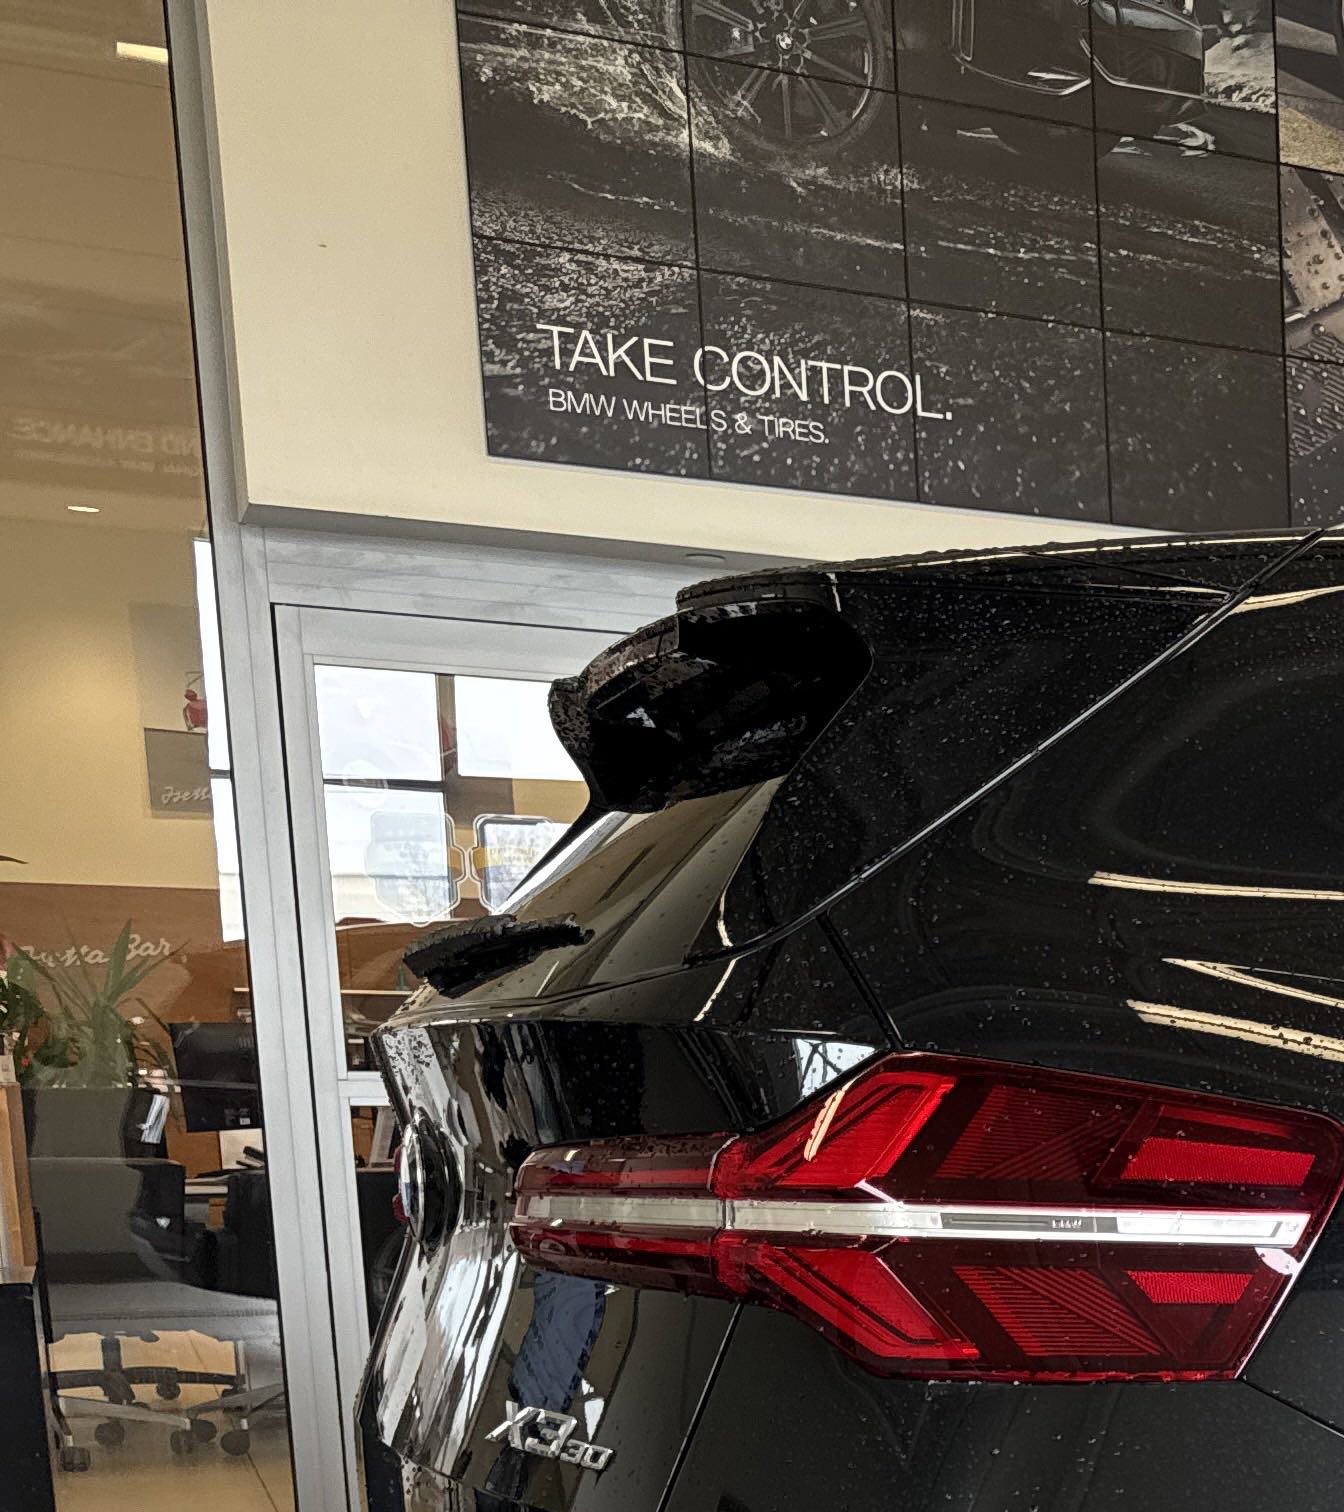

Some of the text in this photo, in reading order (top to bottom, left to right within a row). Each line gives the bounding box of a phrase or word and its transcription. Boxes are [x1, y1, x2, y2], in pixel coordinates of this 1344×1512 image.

[536, 323, 953, 421] TAKE CONTROL.
[548, 388, 829, 444] BMW WHEELS & TIRES.
[484, 1399, 578, 1458] X3
